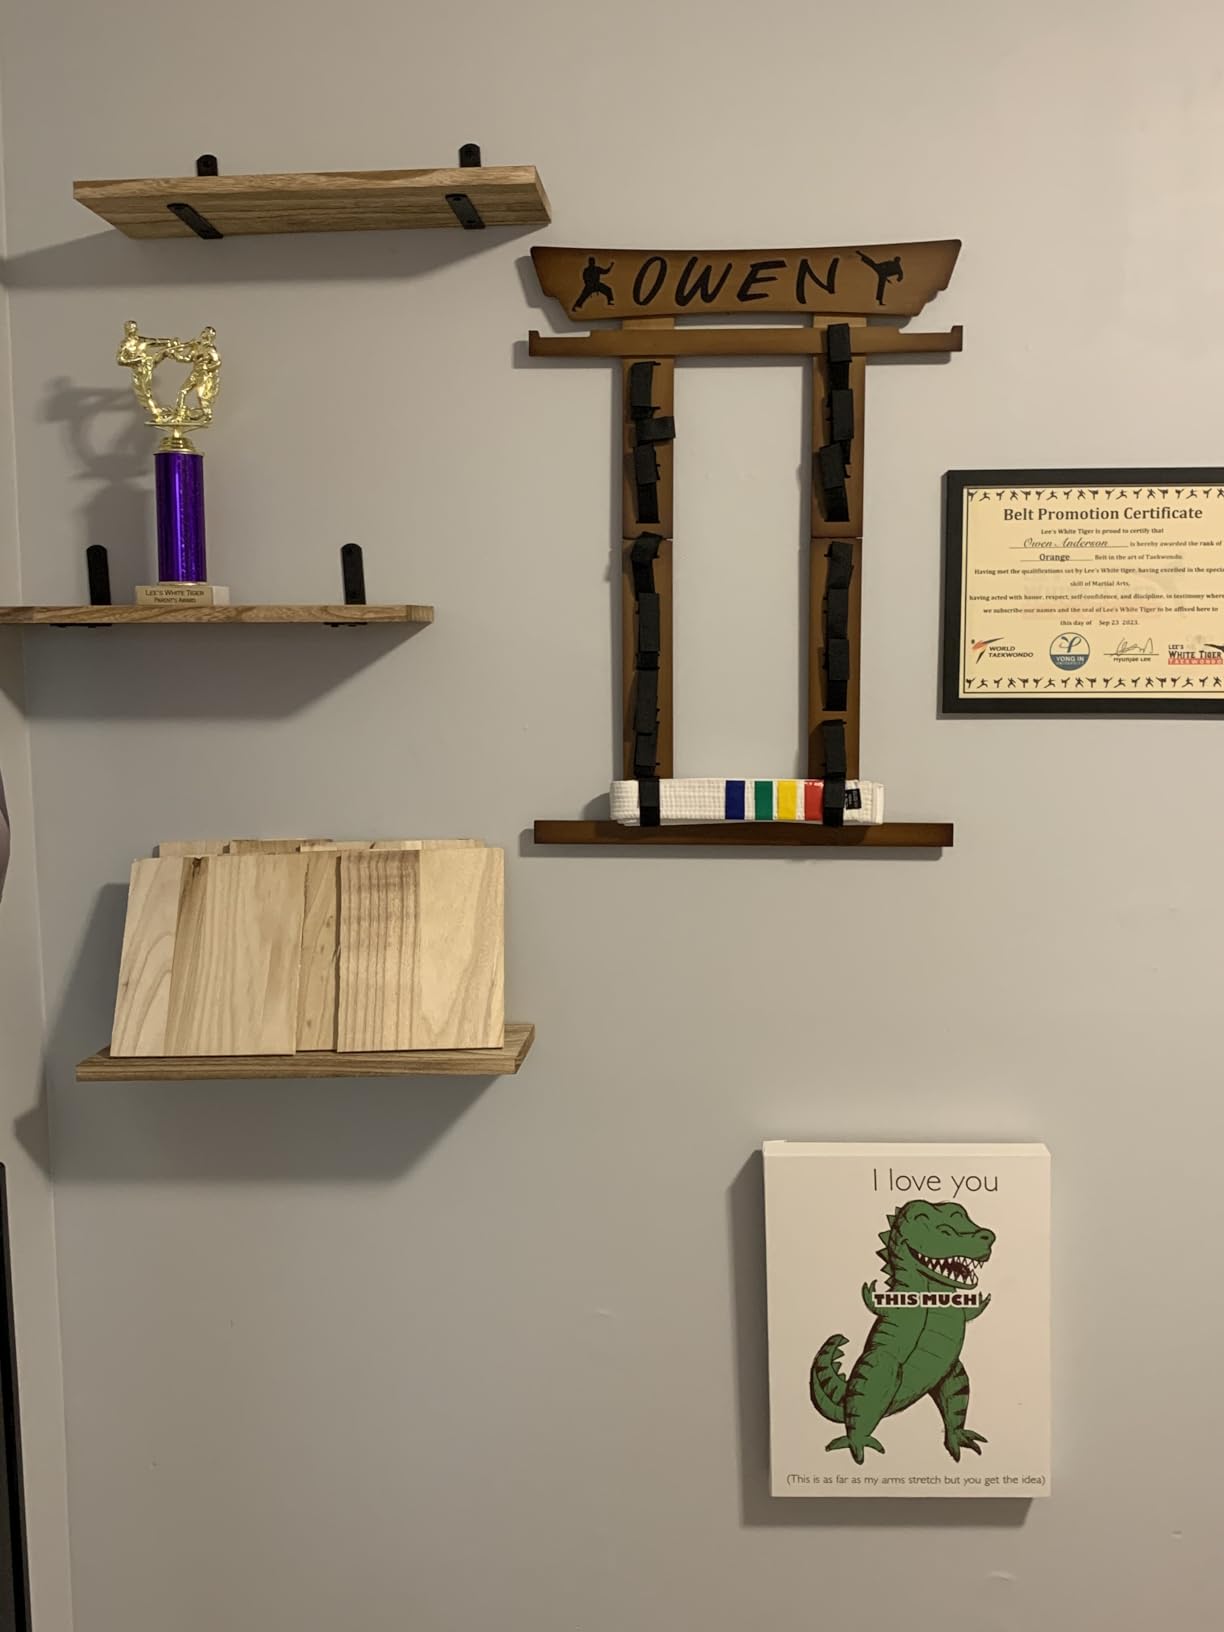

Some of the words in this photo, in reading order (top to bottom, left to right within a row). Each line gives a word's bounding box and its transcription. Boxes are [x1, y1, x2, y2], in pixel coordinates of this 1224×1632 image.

[632, 255, 839, 306] OWEN
[1004, 508, 1034, 520] Belt
[1038, 507, 1119, 520] Promotion
[1124, 507, 1203, 519] Certificate
[1023, 537, 1053, 548] Owen
[1039, 553, 1070, 562] Orange
[874, 1168, 877, 1191] I
[890, 1168, 941, 1191] love
[951, 1176, 997, 1198] you
[874, 1294, 917, 1305] THIS
[922, 1294, 976, 1305] MUCH
[787, 1474, 810, 1485] (This
[813, 1475, 820, 1483] is
[836, 1474, 848, 1483] far
[865, 1477, 878, 1485] my
[908, 1475, 941, 1484] stretch
[945, 1476, 960, 1484] but
[963, 1477, 981, 1486] you
[984, 1477, 999, 1486] get
[1003, 1475, 1018, 1484] the
[1022, 1475, 1045, 1486] idea)
